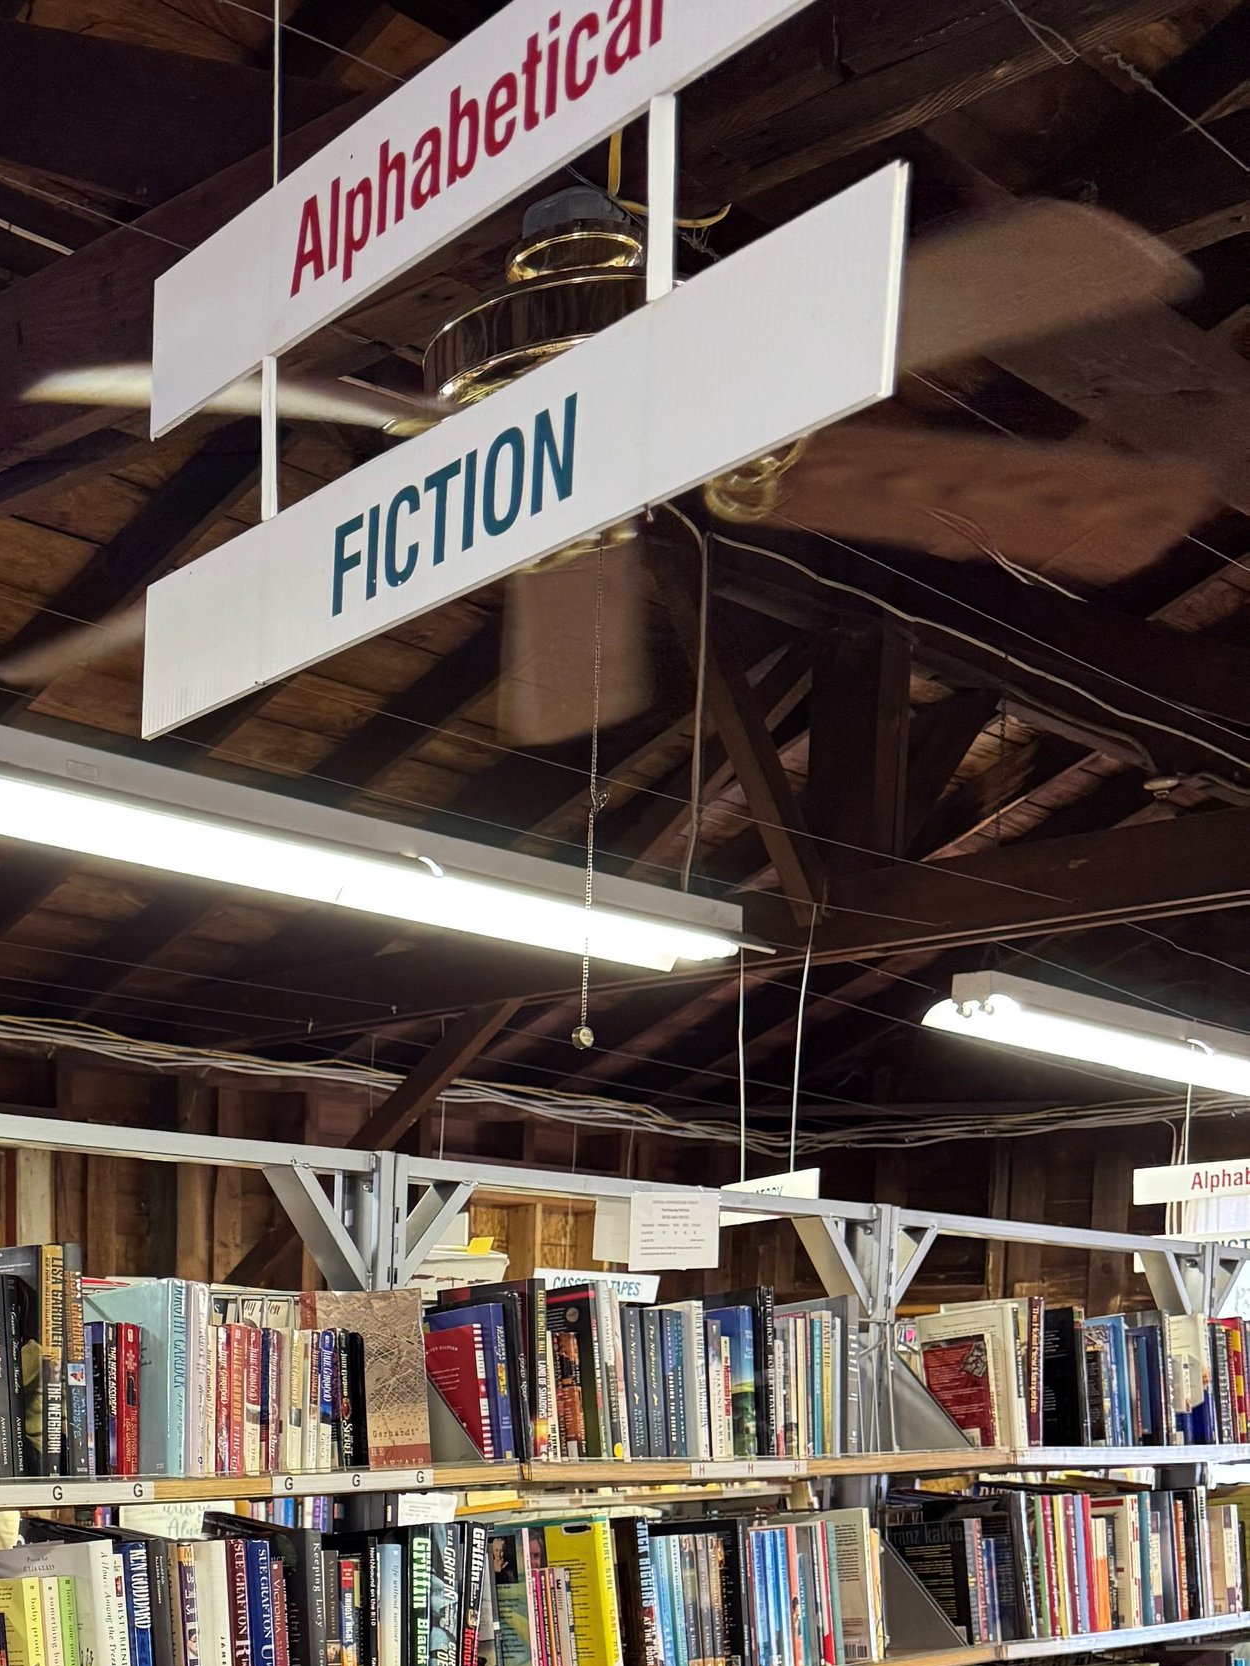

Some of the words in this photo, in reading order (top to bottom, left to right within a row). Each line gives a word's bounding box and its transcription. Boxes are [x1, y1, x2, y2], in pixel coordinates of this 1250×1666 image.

[330, 392, 578, 616] FICTION
[47, 1382, 61, 1405] THE
[47, 1407, 61, 1455] NEIGHBOR
[372, 1428, 416, 1438] Gerhardt
[352, 1473, 360, 1487] G
[699, 1464, 705, 1475] H
[133, 1484, 143, 1497] G
[234, 1540, 244, 1563] SUE
[238, 1565, 251, 1637] GRAFTON
